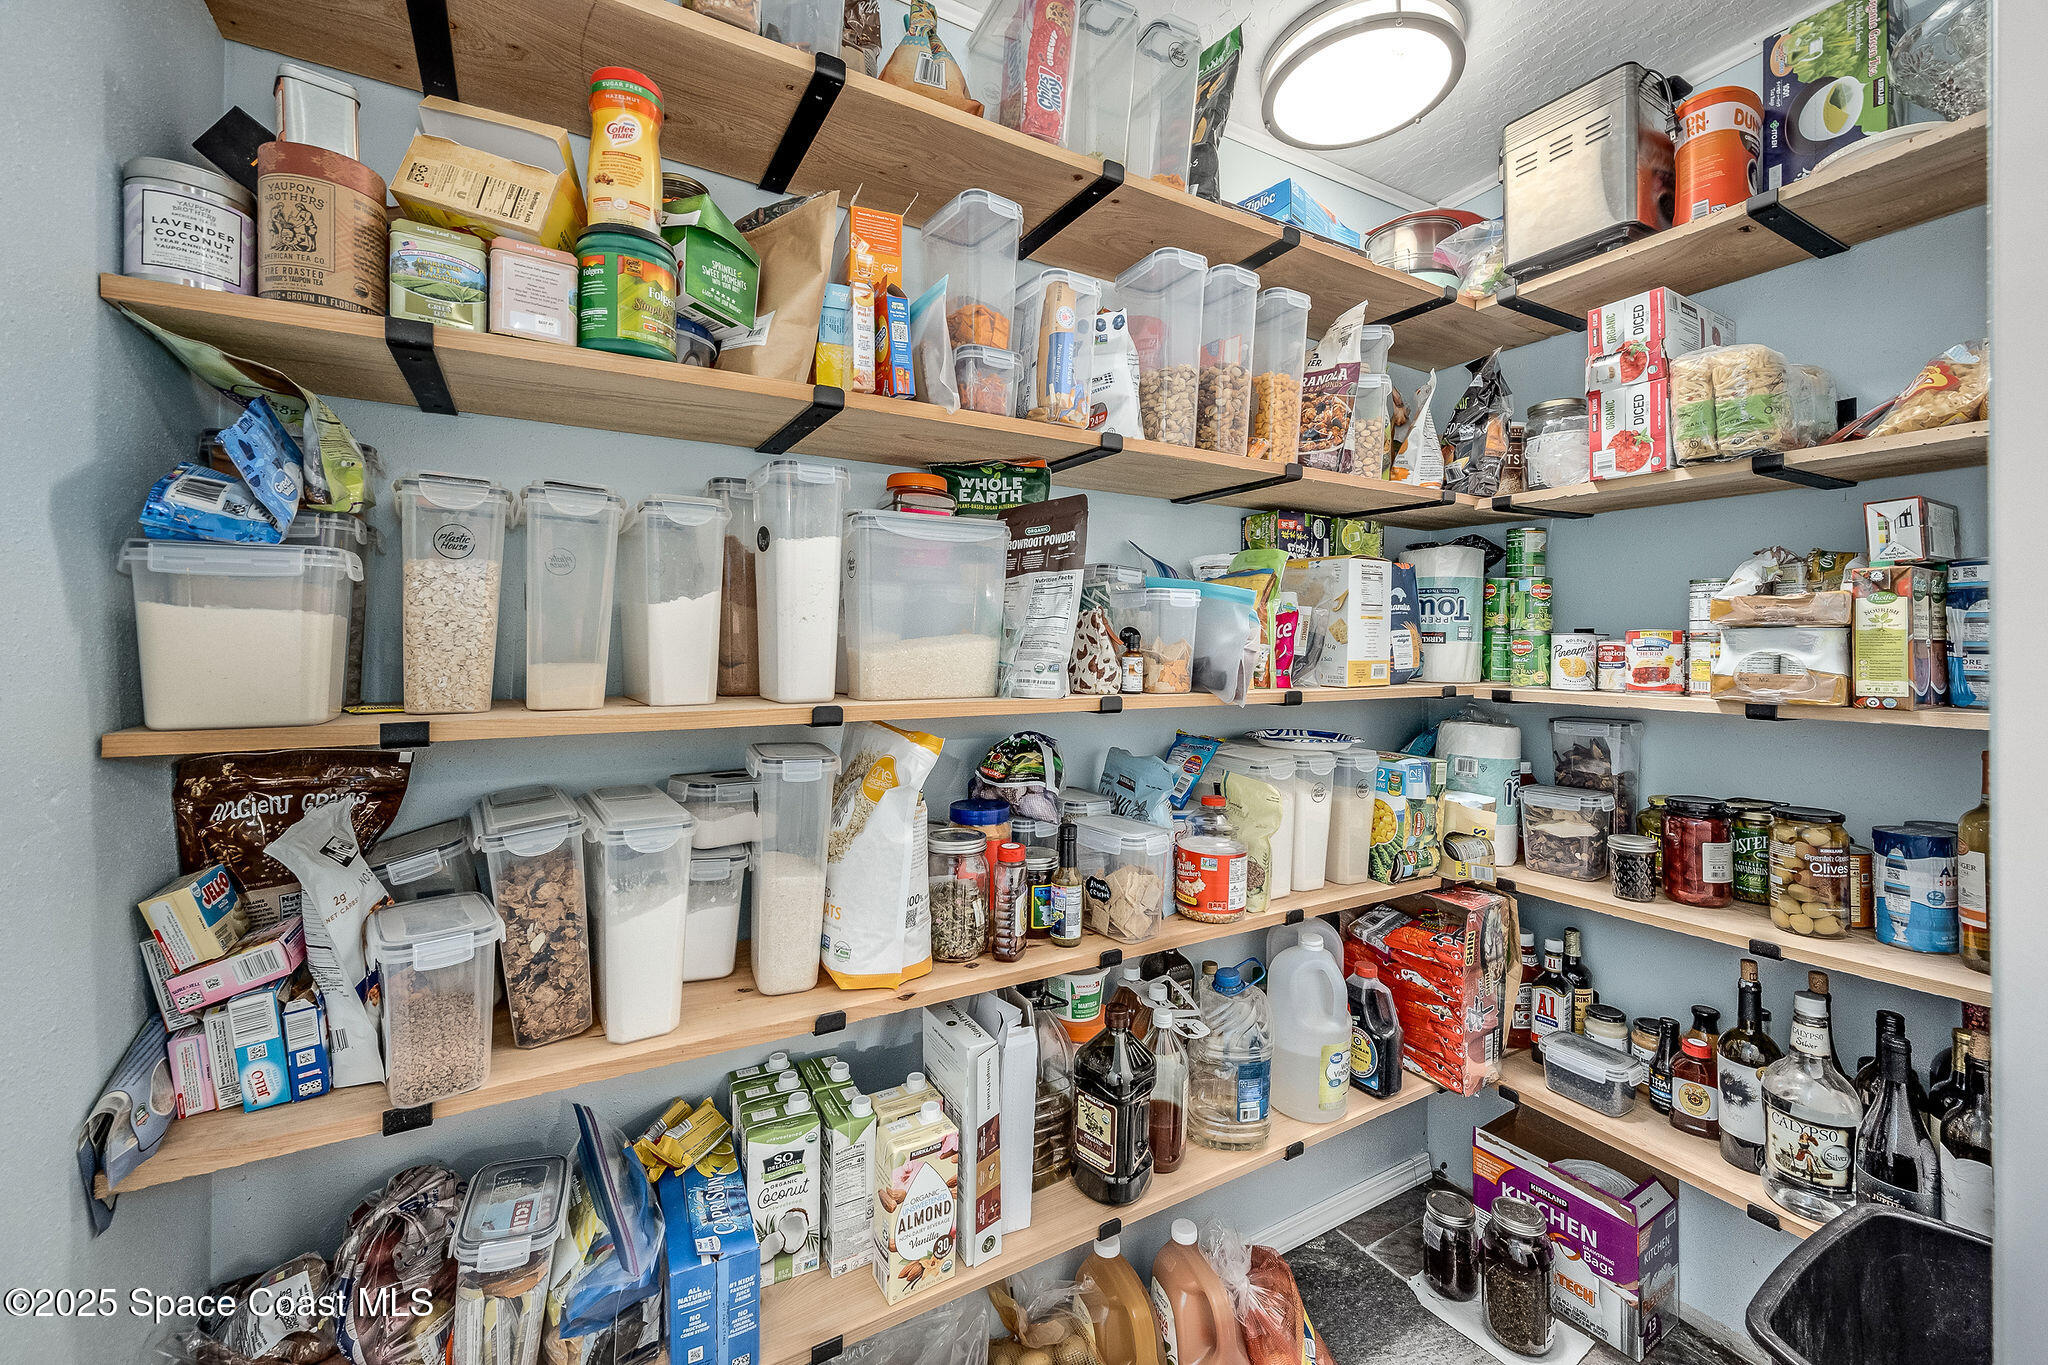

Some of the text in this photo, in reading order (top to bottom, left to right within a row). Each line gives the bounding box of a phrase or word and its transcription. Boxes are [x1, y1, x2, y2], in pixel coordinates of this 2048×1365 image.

[1047, 30, 1058, 67] CHEWY
[1868, 28, 1881, 78] Green Tea
[625, 83, 643, 93] FREE
[1037, 74, 1051, 111] Chips
[605, 93, 640, 104] HAZELNUT
[606, 122, 636, 134] Coffee
[612, 132, 634, 140] mate
[268, 181, 315, 195] YAUPON
[264, 192, 325, 210] BROTHERS
[152, 216, 235, 244] LAVENDER
[156, 228, 231, 252] COCONUT
[264, 266, 324, 279] FIRE ROASTED
[583, 268, 604, 277] Folgers
[711, 260, 737, 276] SPRINKLE
[701, 265, 747, 291] SWEET MOMENTS
[286, 292, 362, 313] GROWN IN FLORIDA
[632, 298, 664, 319] Simply
[1633, 303, 1644, 336] DICED
[1607, 312, 1616, 345] ORGANIC
[1302, 368, 1348, 387] RANOLA
[1606, 399, 1616, 430] ORGANIC
[1633, 393, 1645, 426] DICED
[958, 476, 1023, 491] WHOLE
[959, 489, 1023, 503] EARTH
[957, 503, 984, 511] PLANT-BASED
[438, 530, 471, 547] plastic
[1026, 526, 1050, 535] ORGANIC
[440, 540, 468, 552] House
[1007, 530, 1077, 551] ROWROOT POWDER
[1035, 574, 1074, 584] Nutrition Facts
[1869, 592, 1896, 601] Pacific
[1864, 607, 1900, 616] NOURISH
[1553, 642, 1595, 660] Pineapple
[1733, 834, 1768, 853] OSTER
[1809, 862, 1849, 875] Olives
[325, 898, 359, 925] NET CARBS
[1465, 930, 1476, 966] SHIN
[1792, 1026, 1824, 1041] CALYPSO
[1795, 1037, 1818, 1051] Silver
[1651, 1075, 1671, 1090] THAI
[1771, 1111, 1839, 1143] CALYPSO
[773, 1152, 794, 1165] SO
[910, 1144, 942, 1159] KIRKLAND
[1826, 1152, 1848, 1163] Silver
[767, 1158, 802, 1172] DELICIOUS
[770, 1178, 798, 1190] ORGANIC
[757, 1177, 810, 1209] Coconut
[910, 1189, 940, 1205] ORGANIC
[1530, 1182, 1568, 1208] KIRKLAND
[902, 1193, 948, 1215] UNSWEETENED
[899, 1200, 951, 1234] ALMOND
[923, 1217, 951, 1232] BEVERAGE
[909, 1232, 940, 1249] Vanilla
[937, 1238, 950, 1252] 30
[1582, 1244, 1615, 1266] DRAWSTRING
[1643, 1234, 1671, 1265] KITCHEN
[1583, 1250, 1615, 1277] Bags
[729, 1281, 755, 1293] FAVORITE
[735, 1289, 750, 1299] JUICE
[677, 1290, 711, 1304] NATURAL
[689, 1313, 701, 1321] NO
[737, 1309, 748, 1317] NO
[1647, 1317, 1657, 1334] 13
